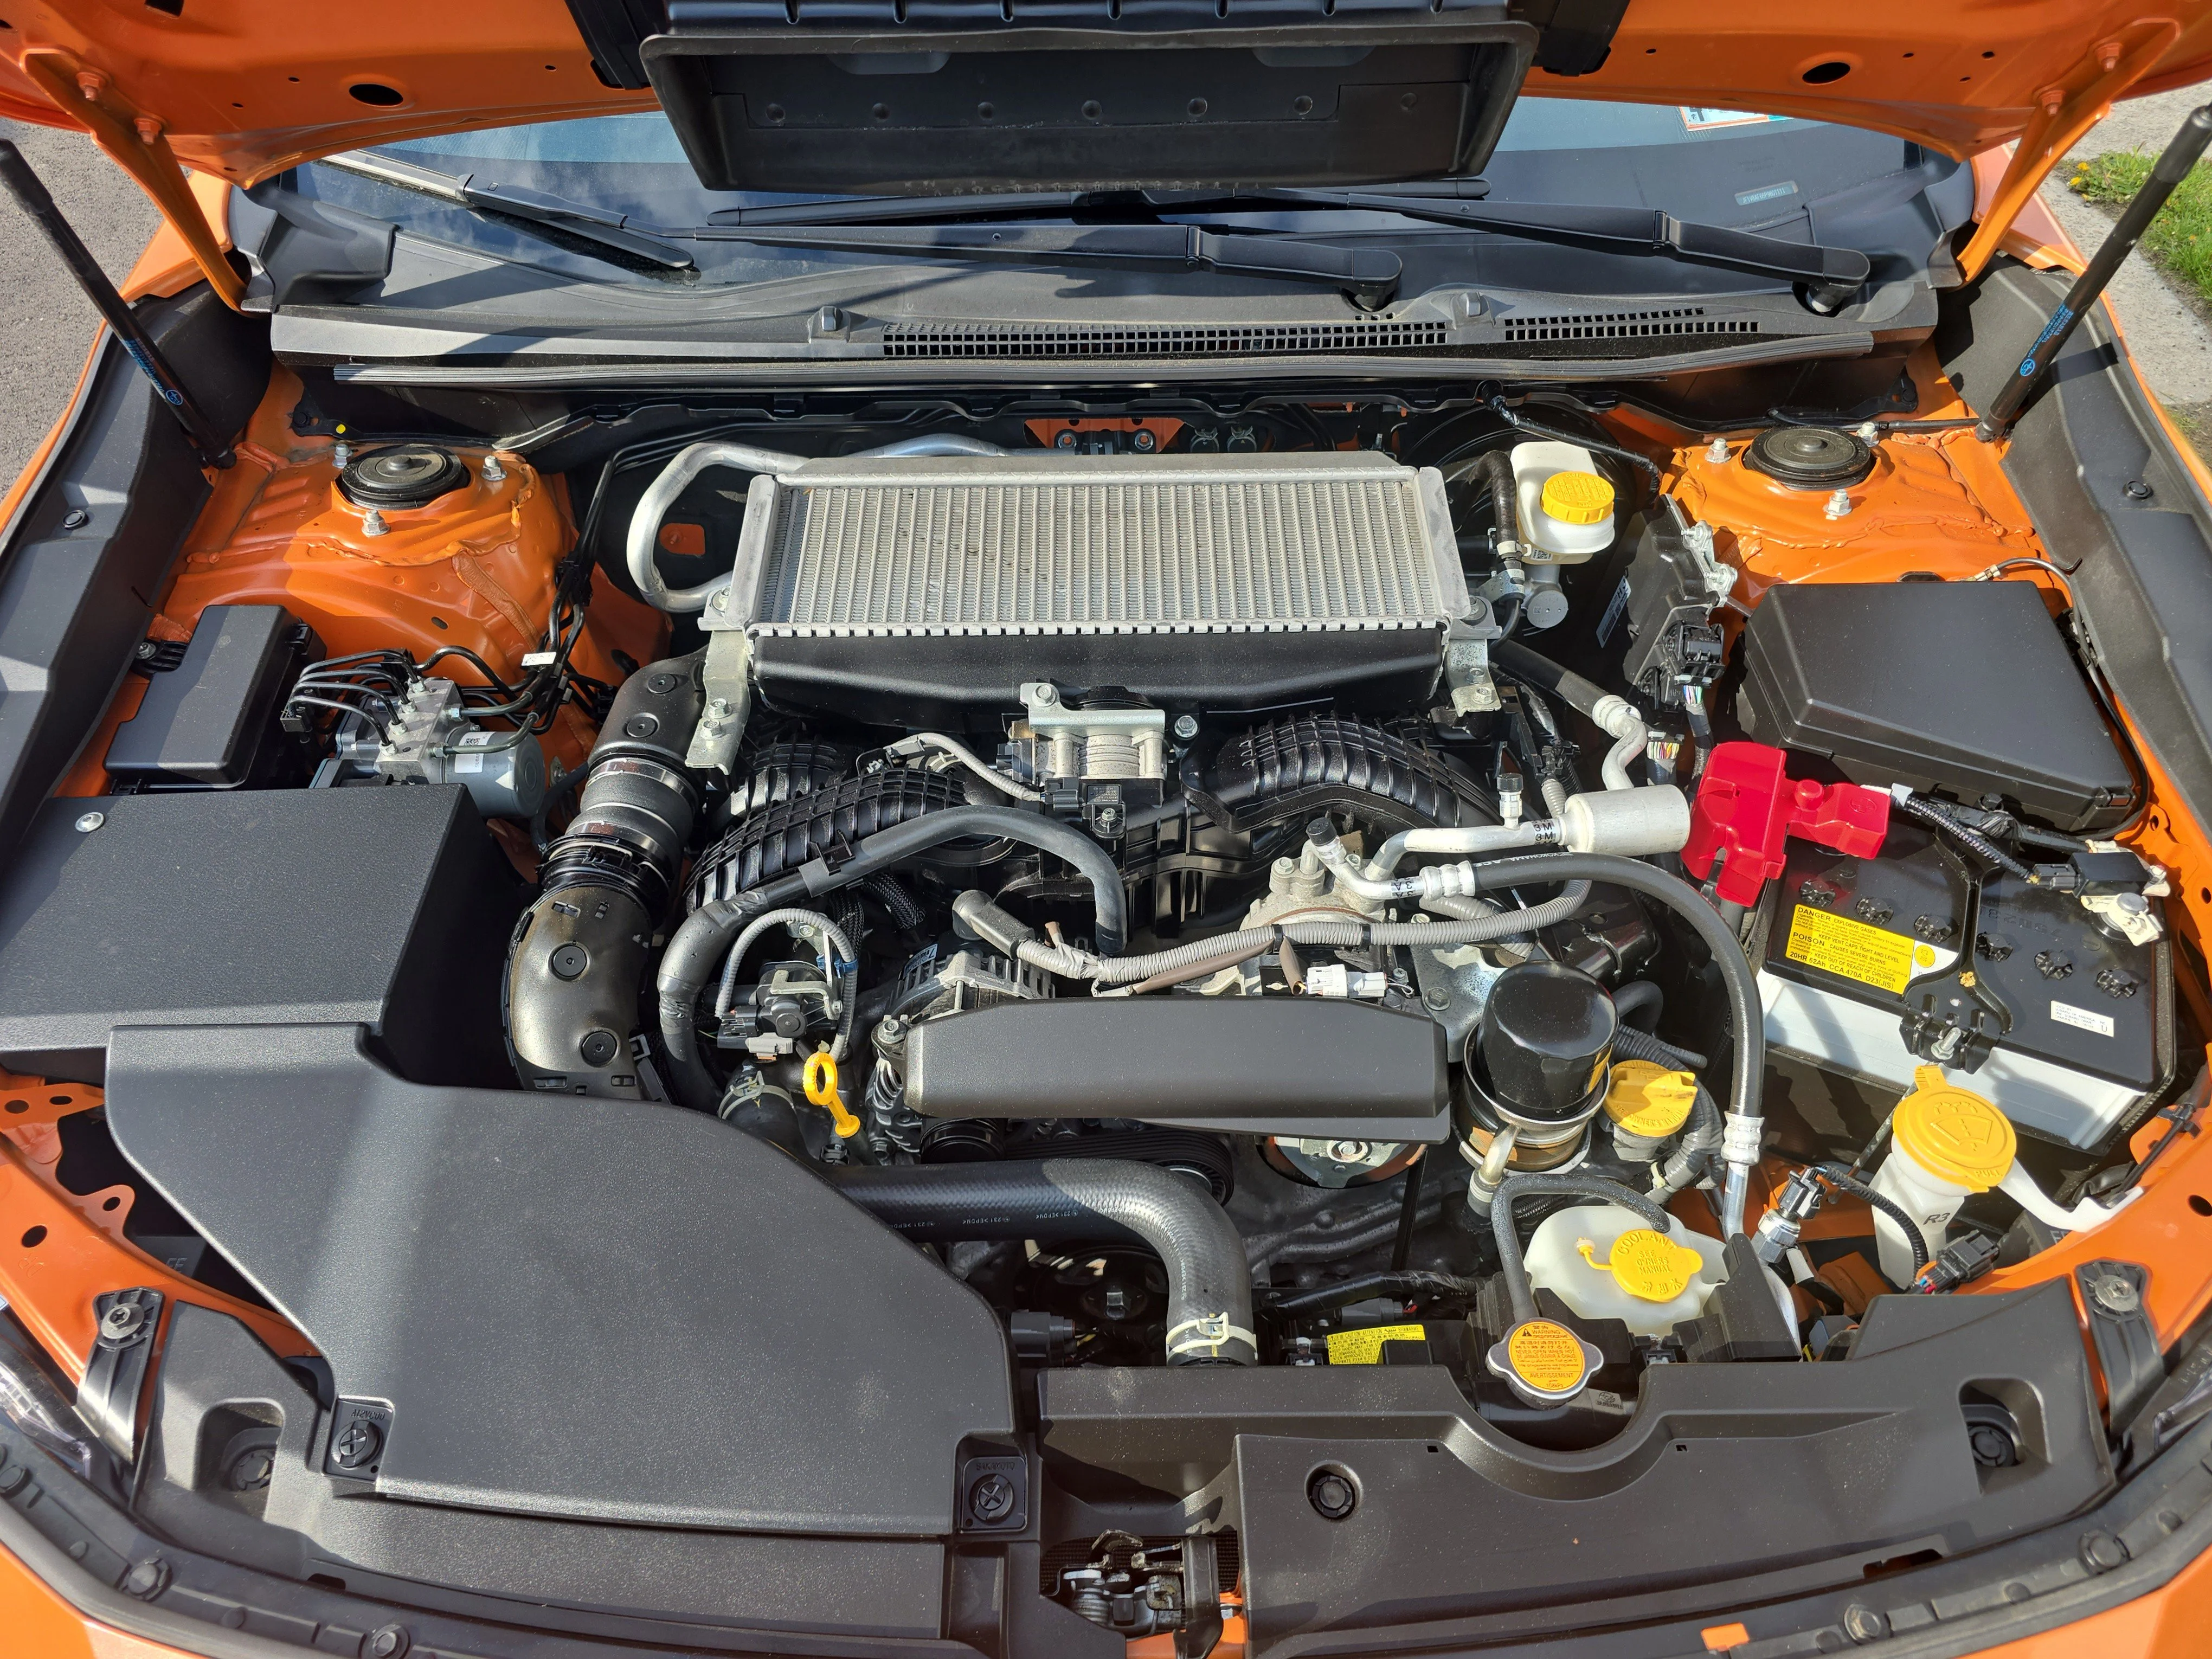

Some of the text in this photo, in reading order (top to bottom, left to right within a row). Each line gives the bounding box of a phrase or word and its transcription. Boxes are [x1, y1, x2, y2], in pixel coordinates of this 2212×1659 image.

[1797, 906, 1876, 935] DANGER EXPLOSIVE GASES
[1792, 931, 1886, 965] POISON CAUSES SEVERE BURNS
[1859, 946, 1873, 954] TIGHT
[1884, 954, 1900, 963] LEVEL
[1789, 951, 1894, 989] 20HR 62Ah CCA 470A D23(JIS)
[1846, 962, 1863, 972] REACH
[1871, 970, 1896, 982] CHILDREN
[1629, 1114, 1660, 1127] OWNER'S
[1661, 1110, 1684, 1126] MANUAL
[1974, 1169, 2003, 1178] PULL
[1923, 1213, 1950, 1225] R3
[1617, 1232, 1677, 1255] COOLANT
[1639, 1265, 1673, 1275] MANUAL
[1596, 1400, 1624, 1410] SUBARU
